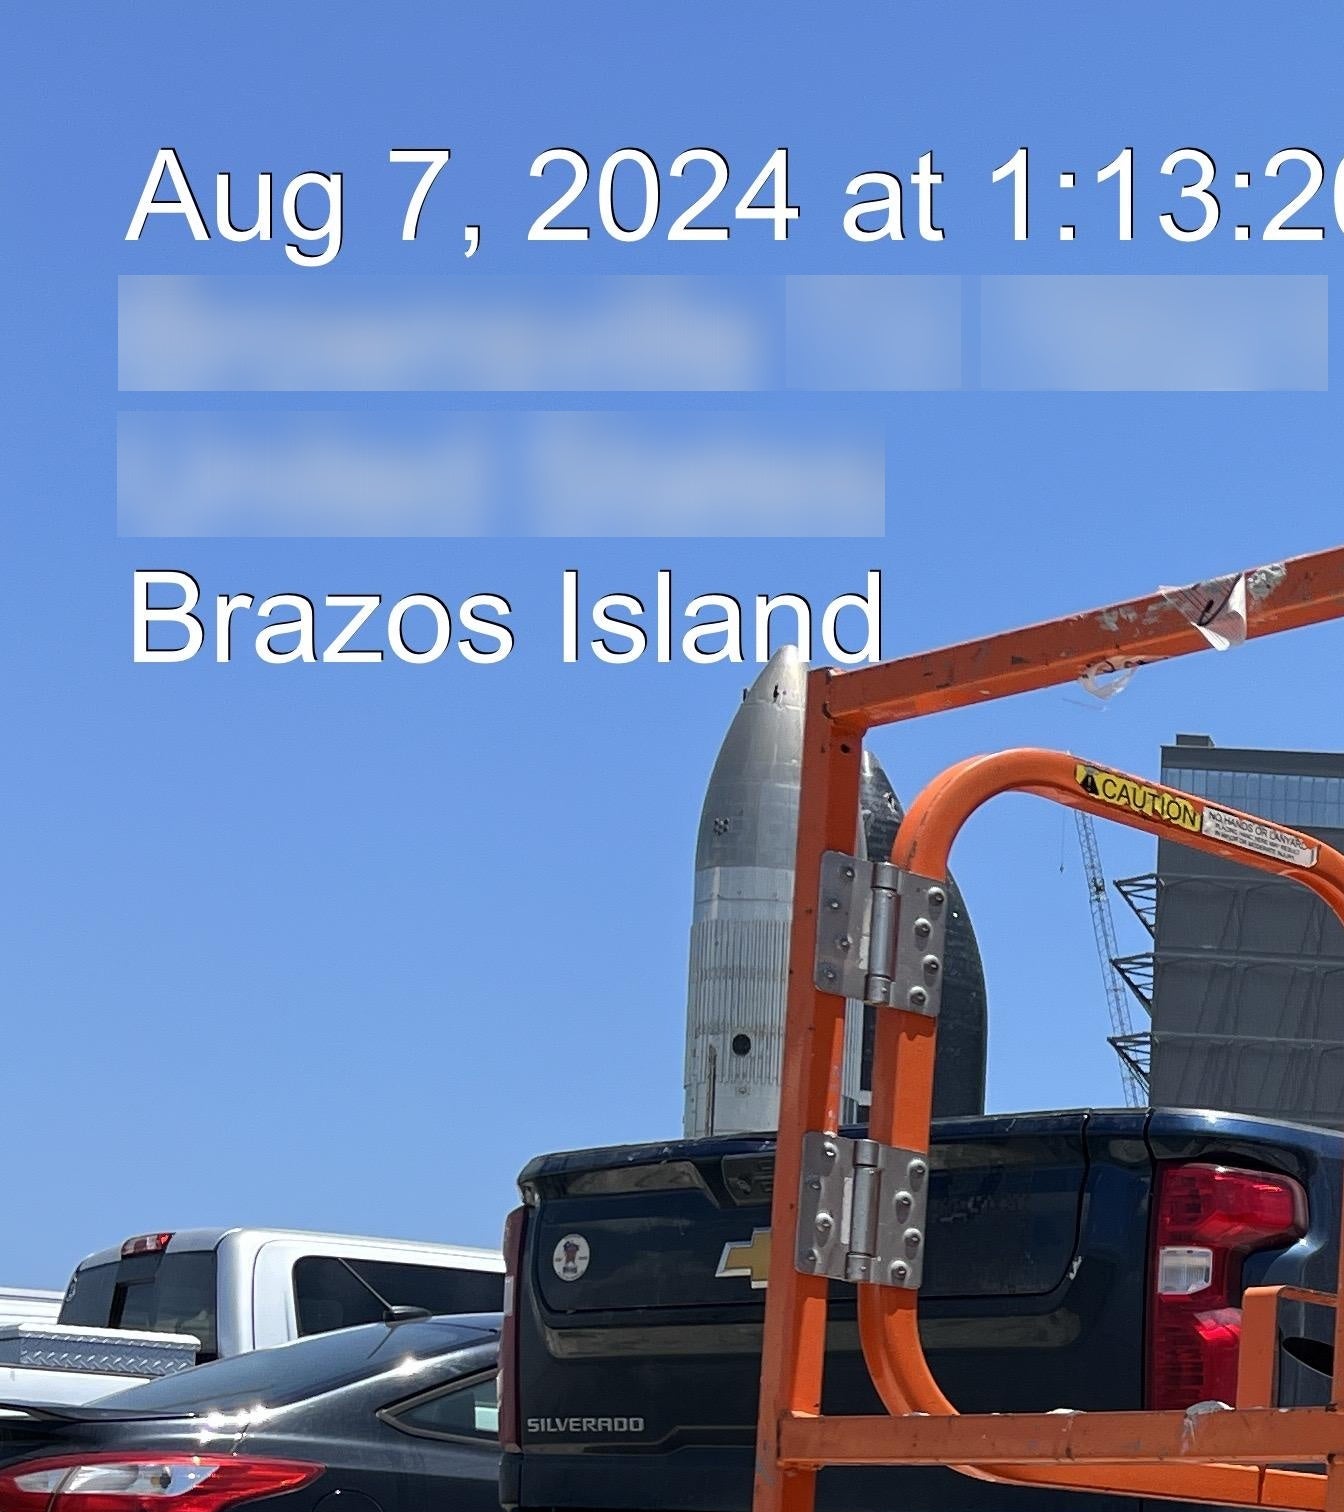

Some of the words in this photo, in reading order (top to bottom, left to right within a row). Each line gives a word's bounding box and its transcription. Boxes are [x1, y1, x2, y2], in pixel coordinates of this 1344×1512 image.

[1102, 778, 1196, 827] CAUTION
[1255, 825, 1268, 837] OR
[527, 1417, 645, 1432] SILVERADO
